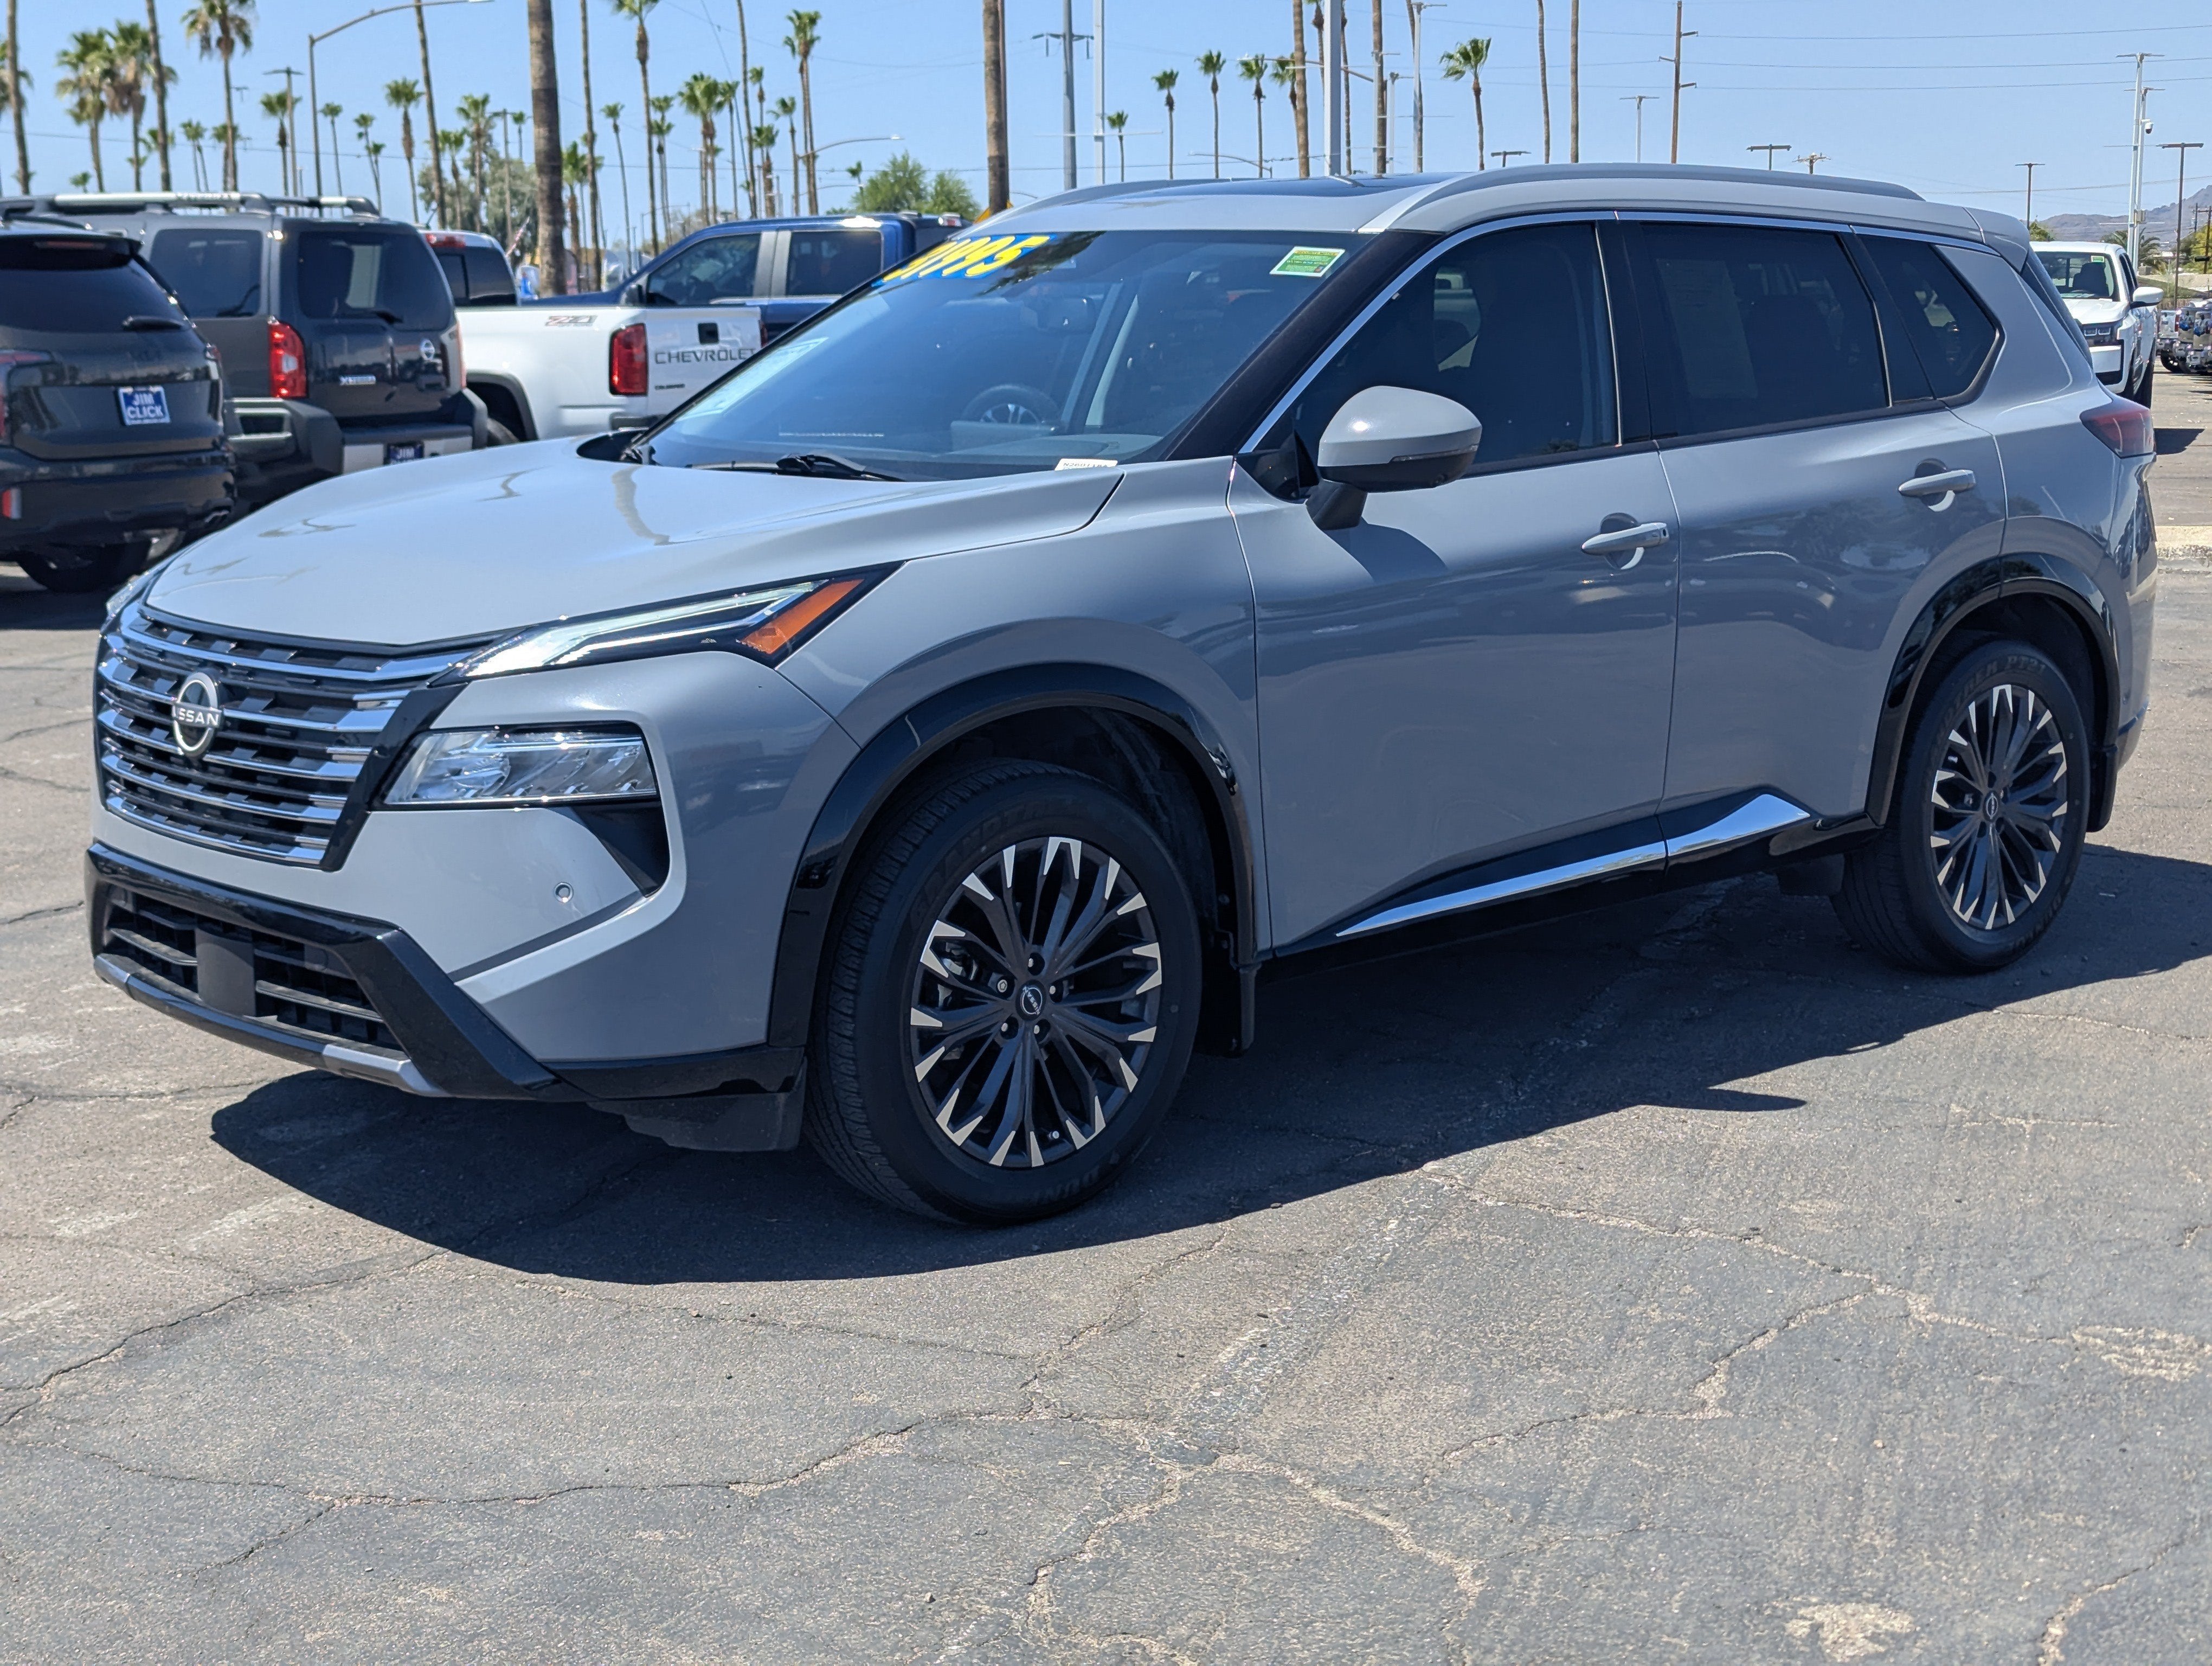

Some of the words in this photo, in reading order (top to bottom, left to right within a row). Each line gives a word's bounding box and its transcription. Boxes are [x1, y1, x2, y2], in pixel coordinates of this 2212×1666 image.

[655, 348, 757, 364] CHEVROLET
[132, 393, 155, 406] JIM
[127, 406, 164, 419] CLICK
